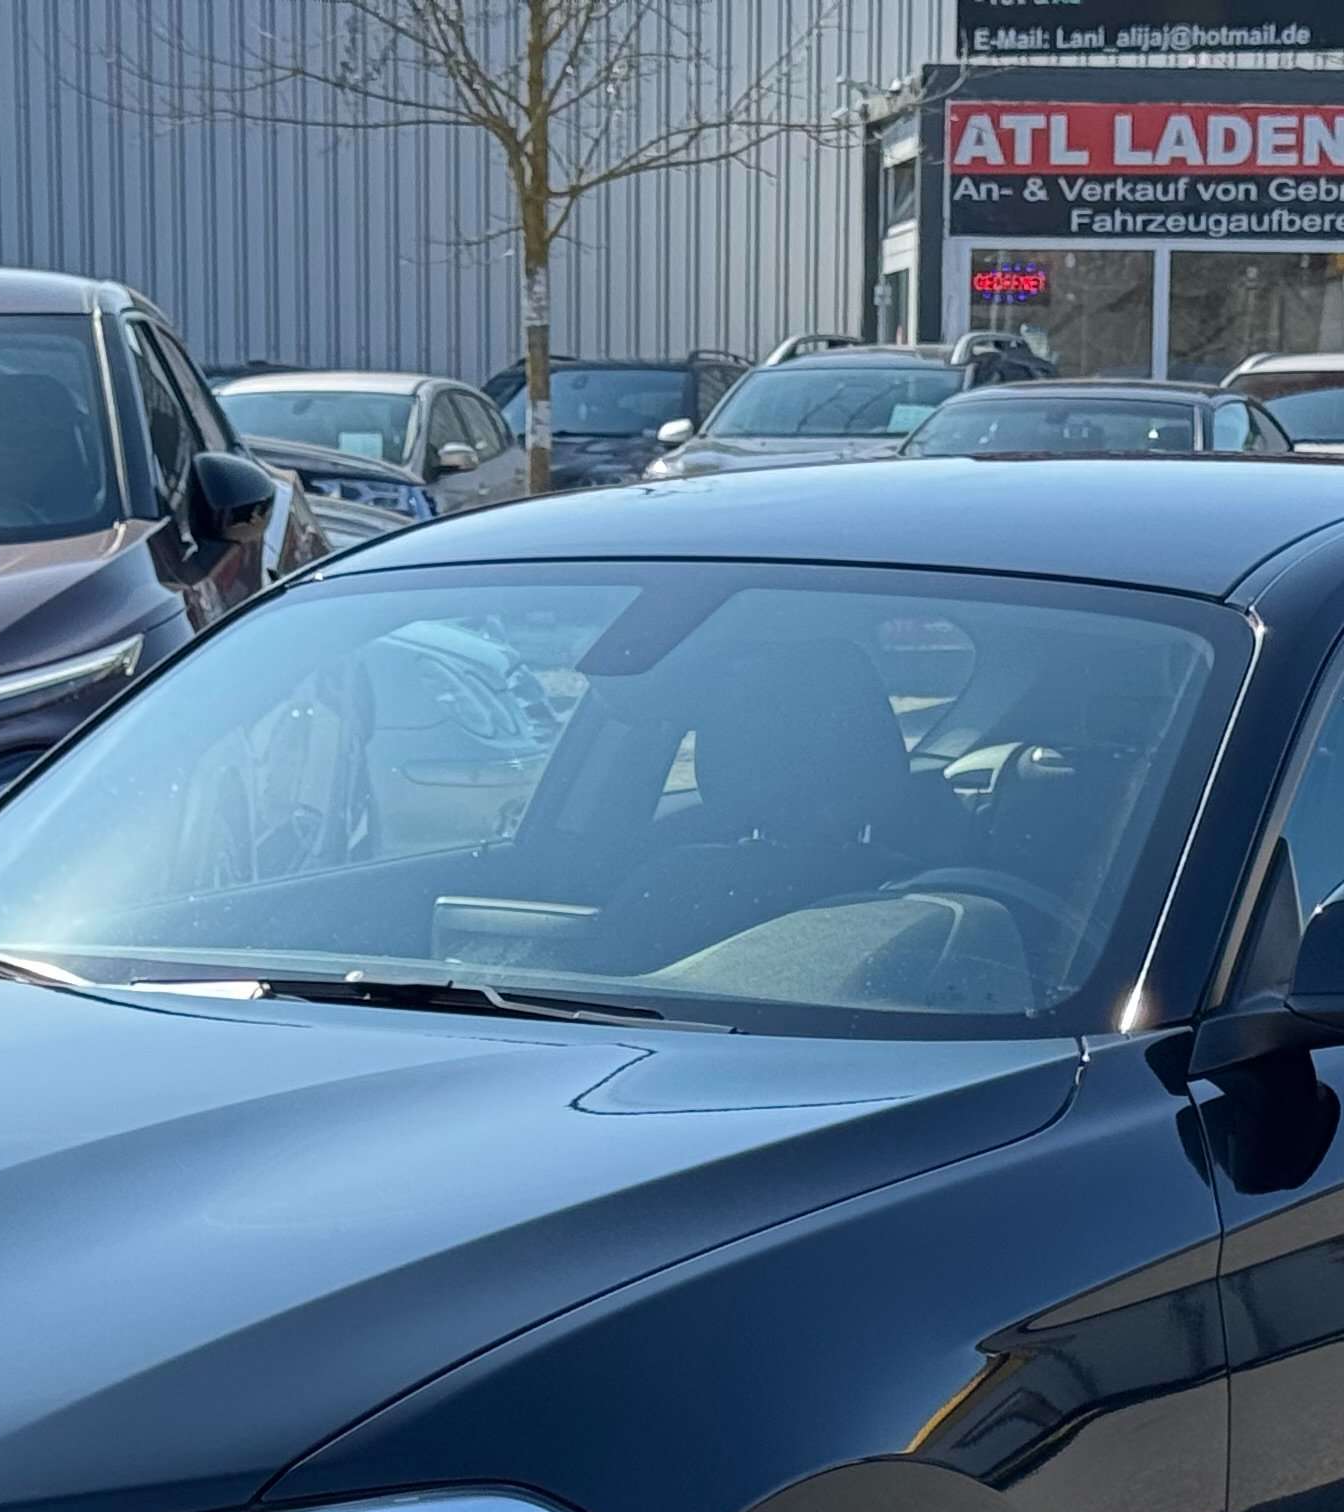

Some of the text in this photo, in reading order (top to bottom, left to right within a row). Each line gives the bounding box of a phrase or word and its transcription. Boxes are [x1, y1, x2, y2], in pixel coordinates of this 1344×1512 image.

[973, 26, 1050, 50] E-Mail:
[953, 112, 1090, 166] ATL
[953, 176, 1014, 201] An-
[1022, 176, 1049, 202] &
[1058, 176, 1190, 202] Verkauf
[1196, 182, 1257, 202] von
